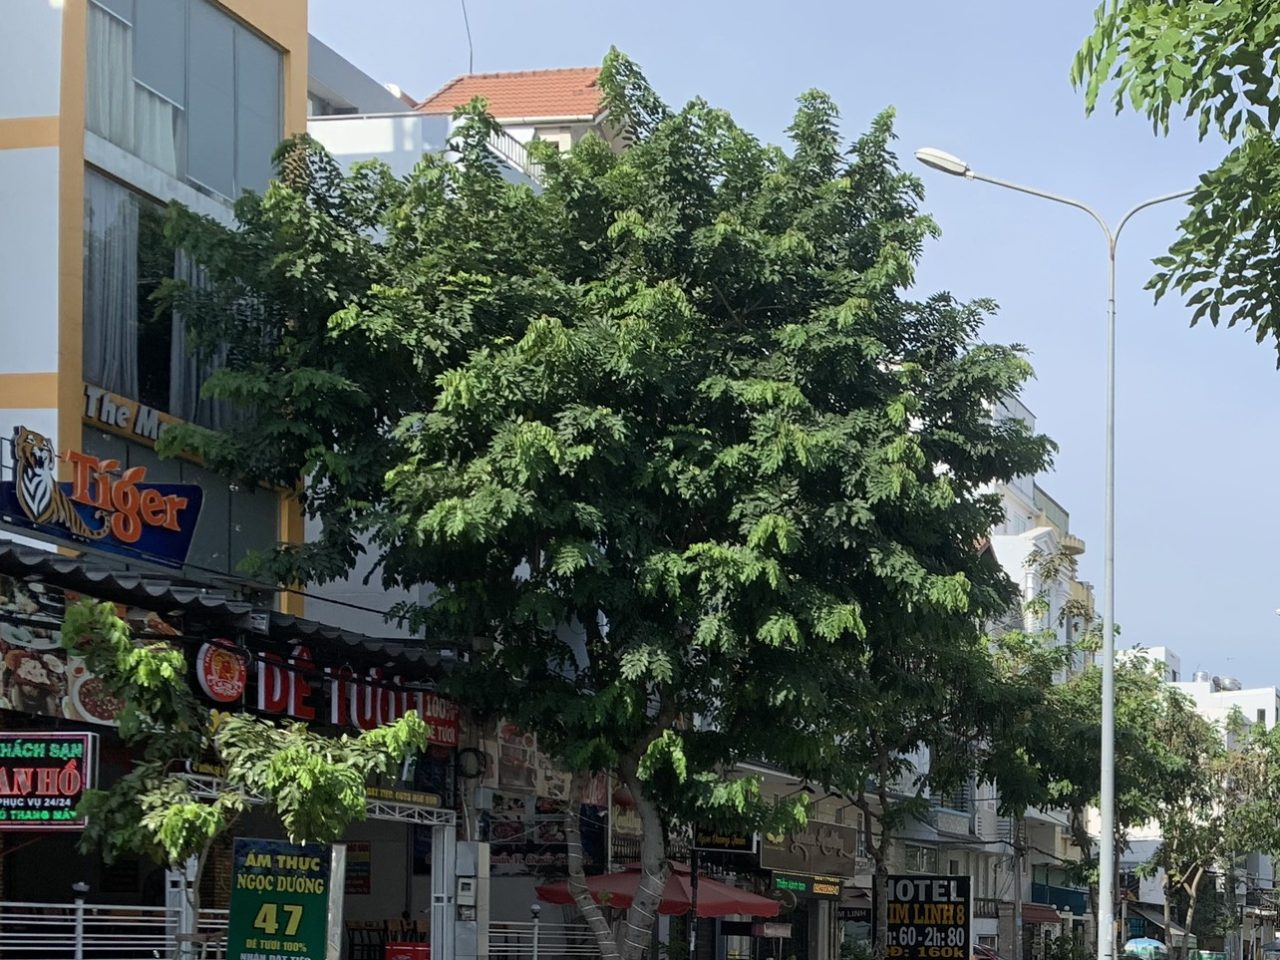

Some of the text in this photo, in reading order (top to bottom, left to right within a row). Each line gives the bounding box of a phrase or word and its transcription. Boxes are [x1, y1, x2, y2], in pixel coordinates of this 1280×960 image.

[84, 384, 130, 428] The
[69, 447, 188, 543] Tiger
[258, 645, 316, 721] DÊ
[0, 739, 83, 760] HÁCH SẠN
[27, 798, 41, 809] VỤ
[44, 798, 71, 807] 24/24
[237, 873, 274, 894] NGỌC
[253, 903, 303, 936] 47
[889, 903, 965, 926] IM LINH 8
[283, 942, 307, 952] 100%
[899, 926, 917, 946] 60
[947, 928, 965, 947] 80
[917, 946, 965, 958] 160k
